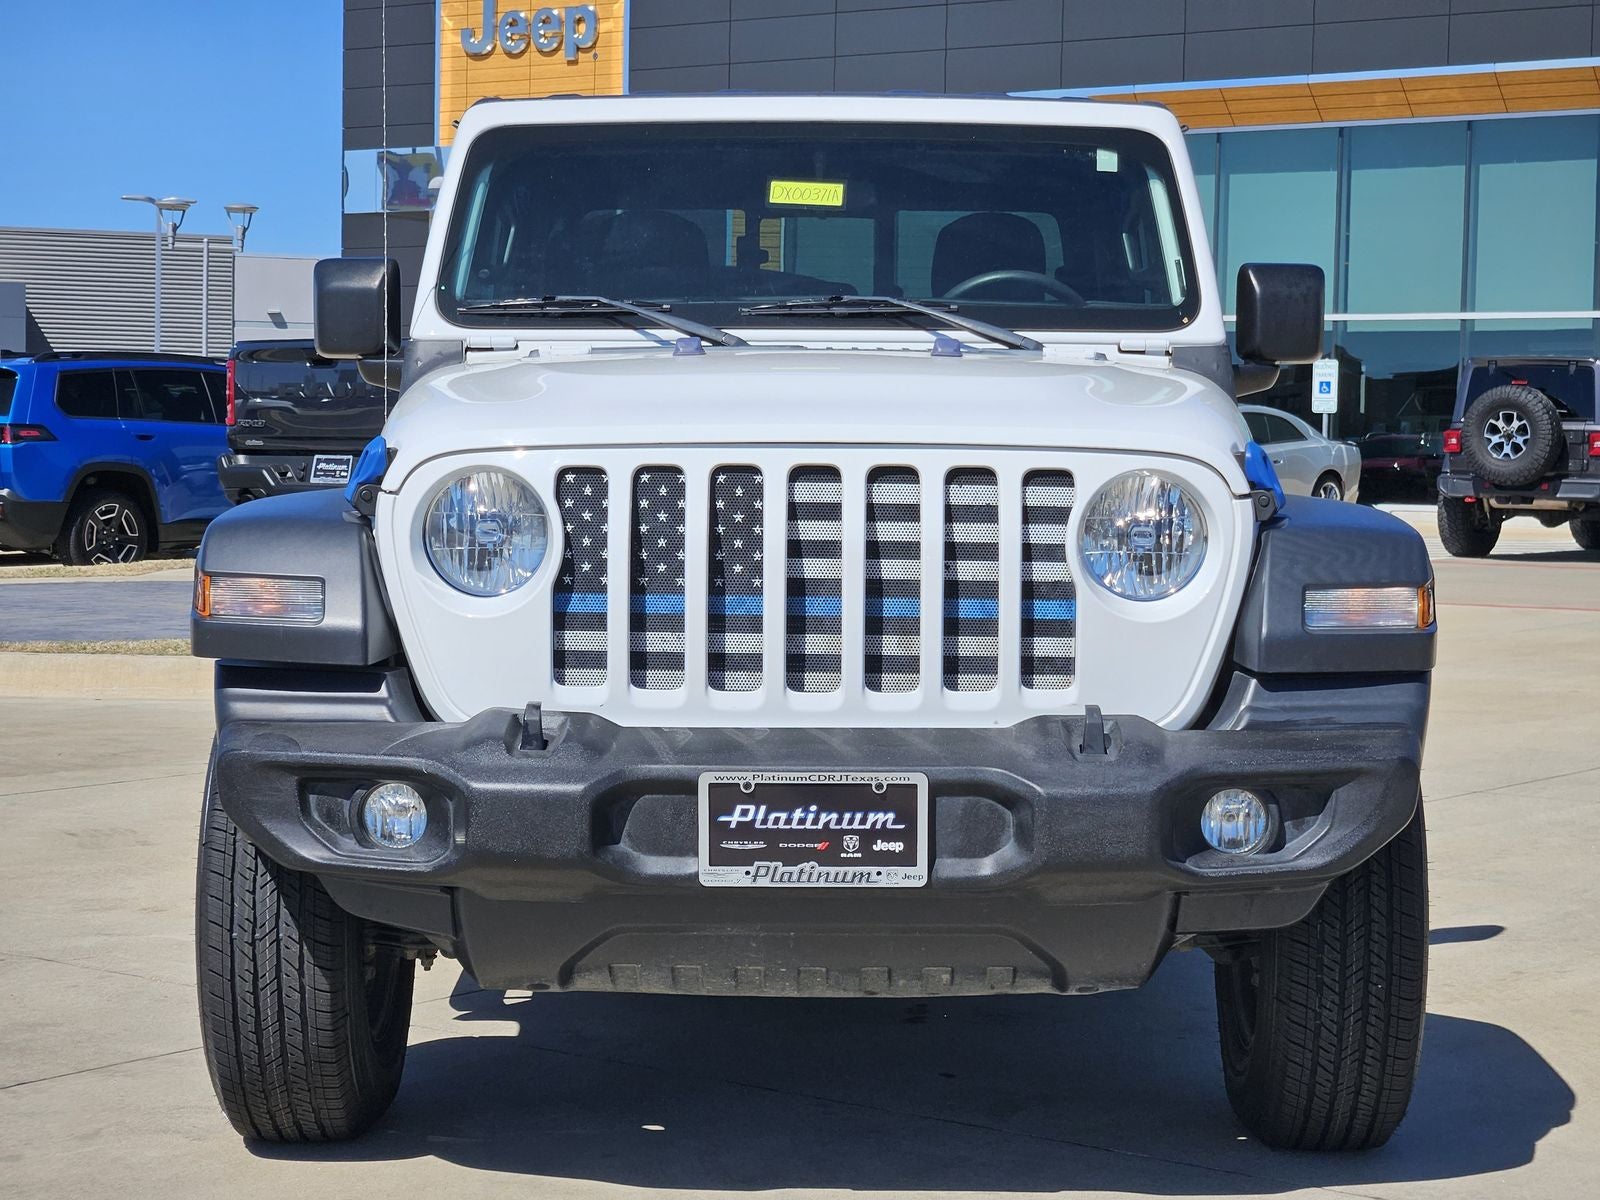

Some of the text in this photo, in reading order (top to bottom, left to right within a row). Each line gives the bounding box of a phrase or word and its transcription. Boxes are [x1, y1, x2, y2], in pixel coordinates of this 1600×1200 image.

[461, 0, 598, 60] Jeep
[714, 773, 910, 783] www.PlatinumCDRJTexas.com
[717, 804, 906, 830] Platinum
[872, 839, 904, 853] Jeep
[751, 864, 879, 884] Platinum
[901, 872, 924, 882] Jeep
